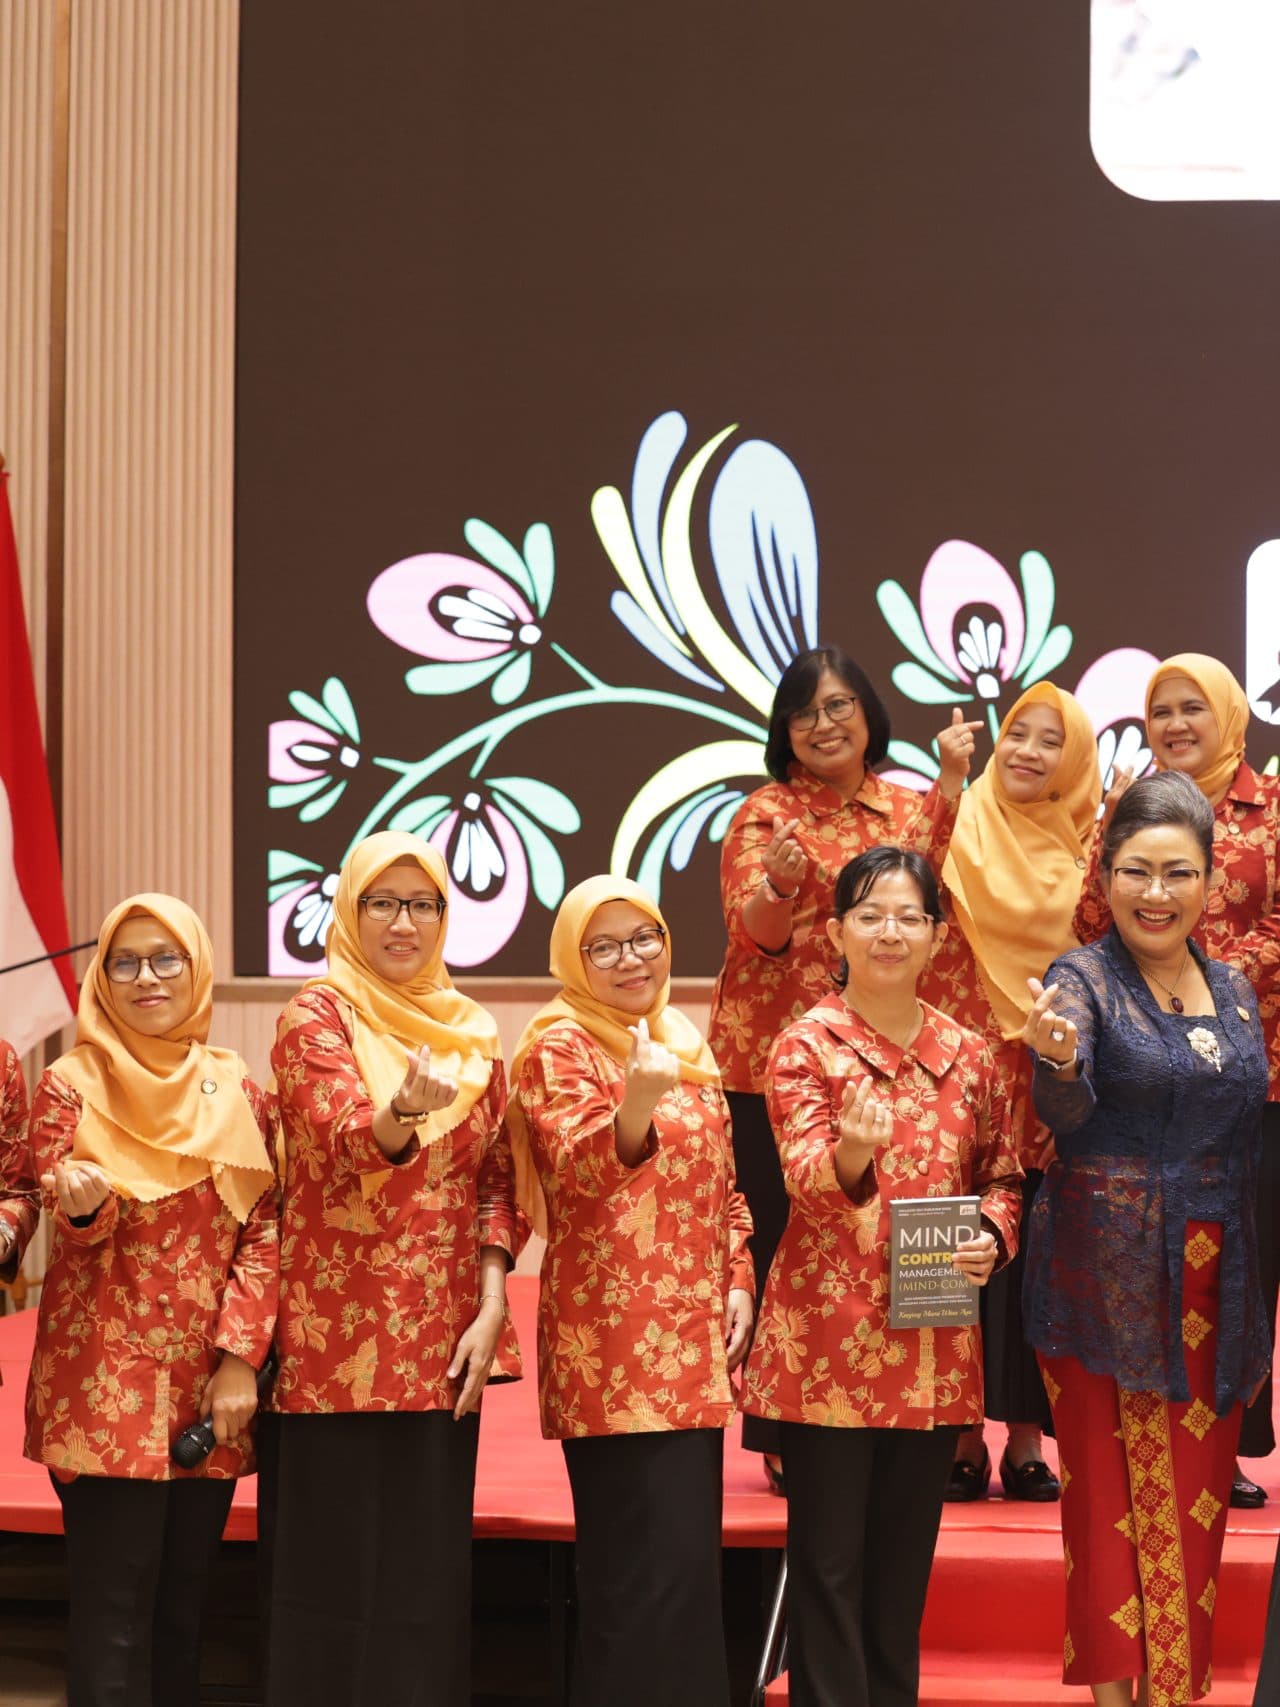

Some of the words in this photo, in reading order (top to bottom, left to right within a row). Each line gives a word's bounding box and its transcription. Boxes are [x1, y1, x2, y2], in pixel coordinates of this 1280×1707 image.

[900, 1225, 974, 1249] MIND
[898, 1252, 953, 1266] CONTR
[899, 1267, 964, 1279] MANAGEME
